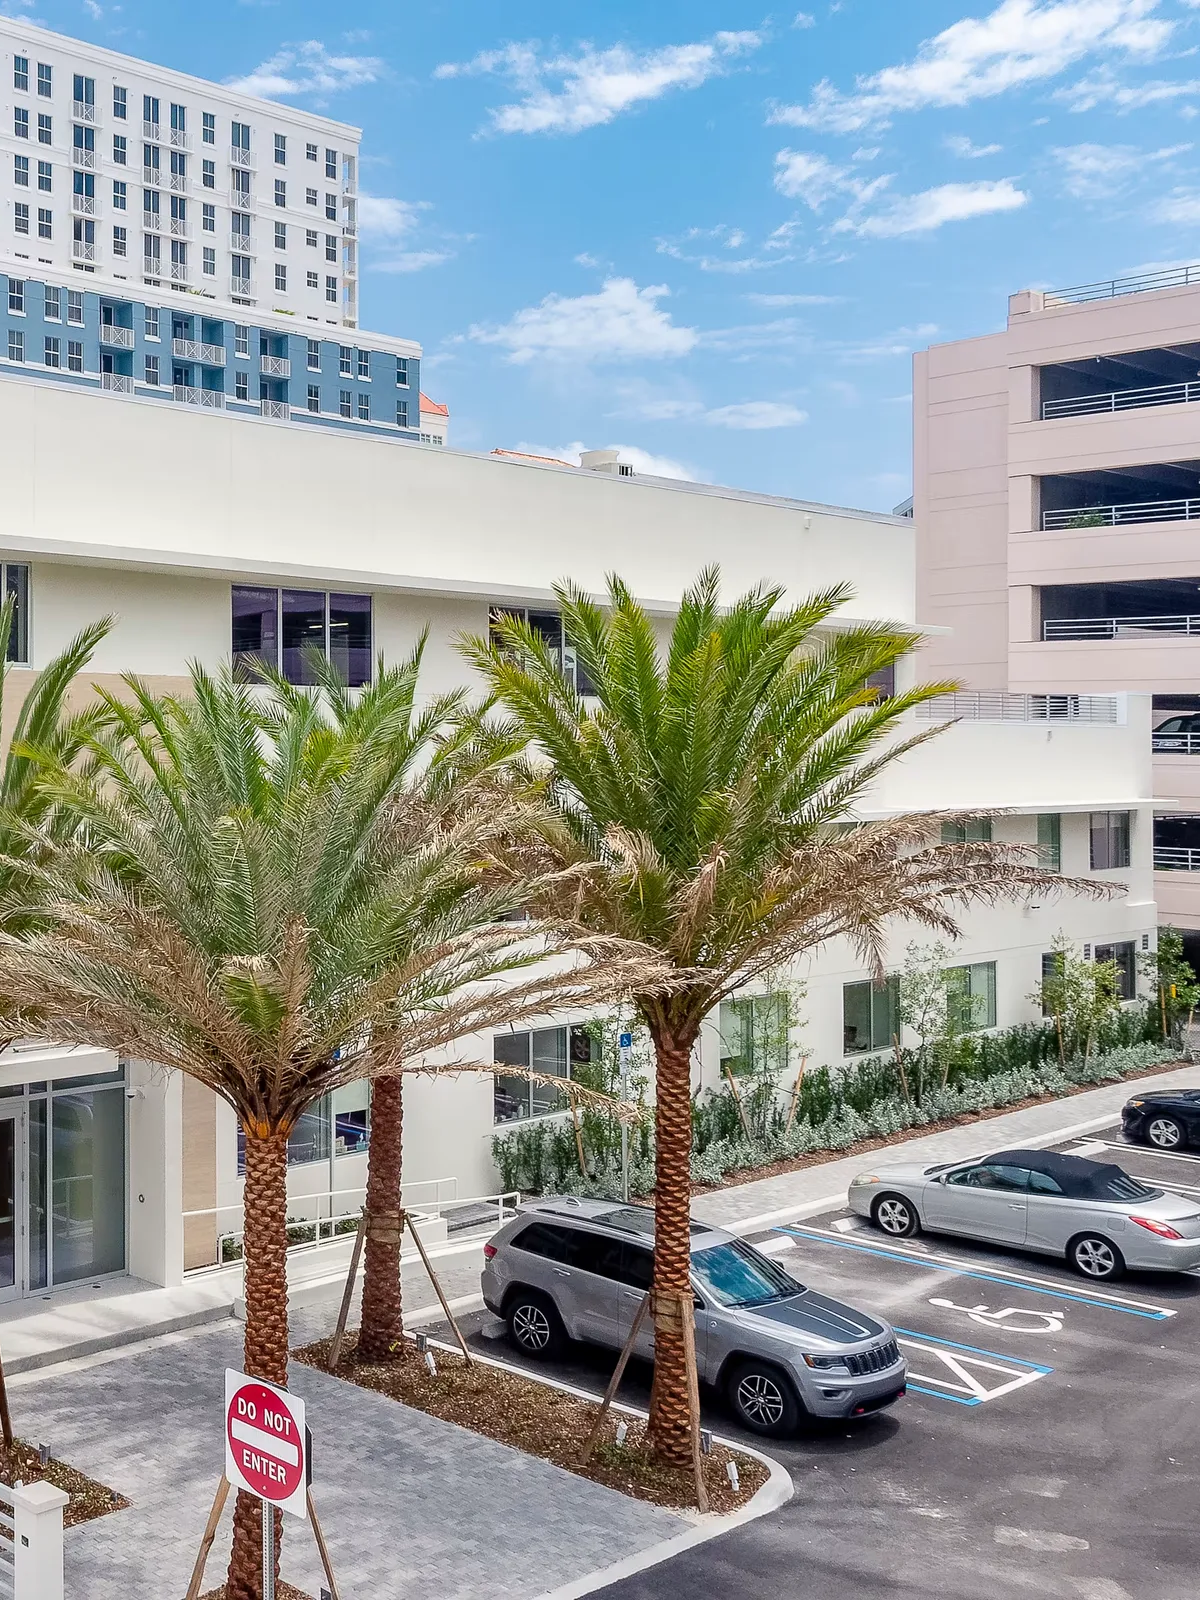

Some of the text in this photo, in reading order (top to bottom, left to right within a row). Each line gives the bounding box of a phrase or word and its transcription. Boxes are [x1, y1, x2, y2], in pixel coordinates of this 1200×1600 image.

[238, 1397, 292, 1435] DO NOT
[243, 1448, 287, 1485] ENTER
